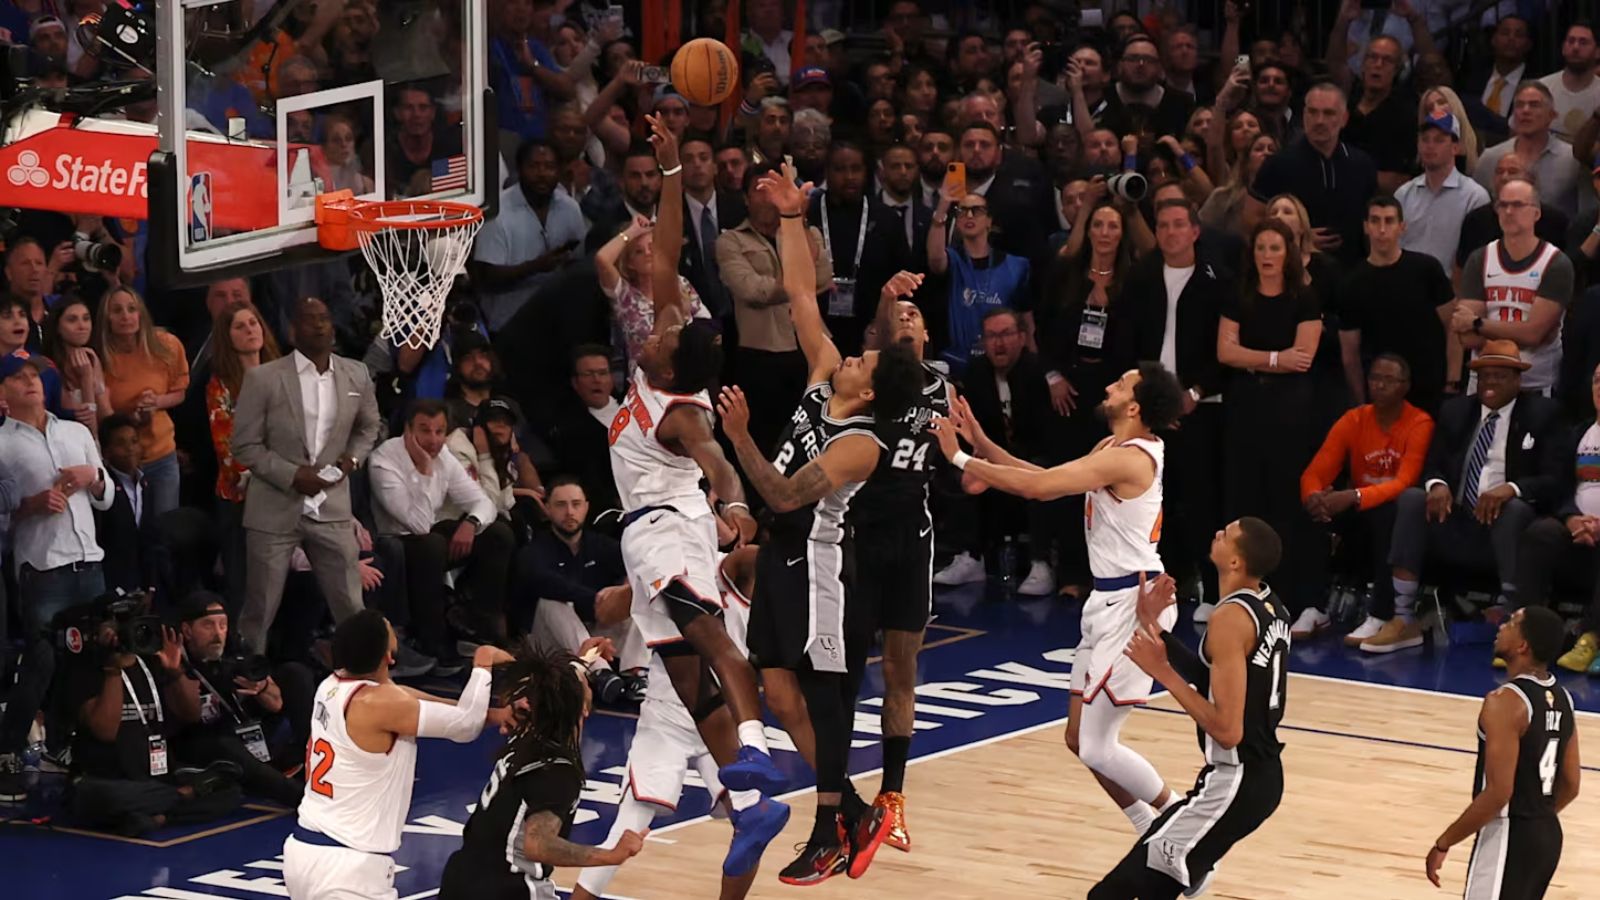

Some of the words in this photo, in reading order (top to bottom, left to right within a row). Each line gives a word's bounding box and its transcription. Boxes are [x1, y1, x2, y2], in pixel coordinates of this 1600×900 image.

[608, 406, 631, 447] 8
[773, 440, 796, 476] 2
[891, 438, 931, 472] 24
[1268, 650, 1282, 710] 1
[1539, 737, 1560, 796] 4
